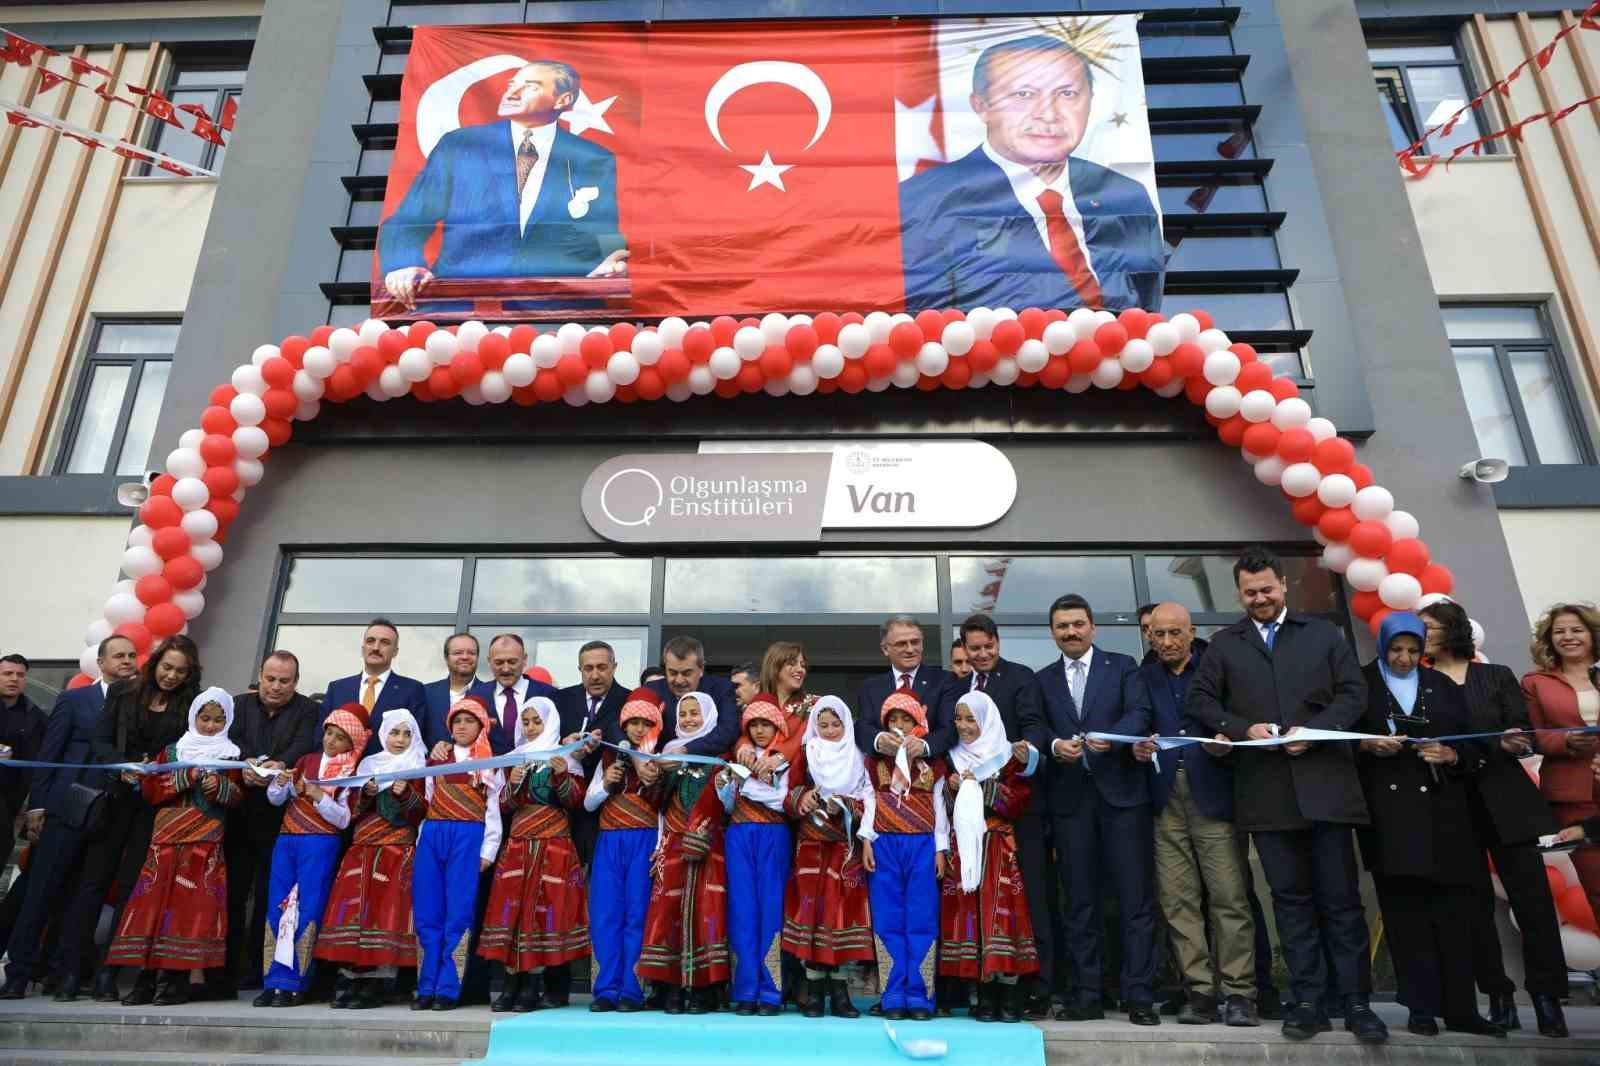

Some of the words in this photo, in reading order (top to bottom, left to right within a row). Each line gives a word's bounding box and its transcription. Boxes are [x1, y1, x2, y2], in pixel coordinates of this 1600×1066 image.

[670, 475, 807, 498] Olgunlaşma
[670, 497, 793, 516] Enstitüleri
[846, 484, 916, 513] Van
